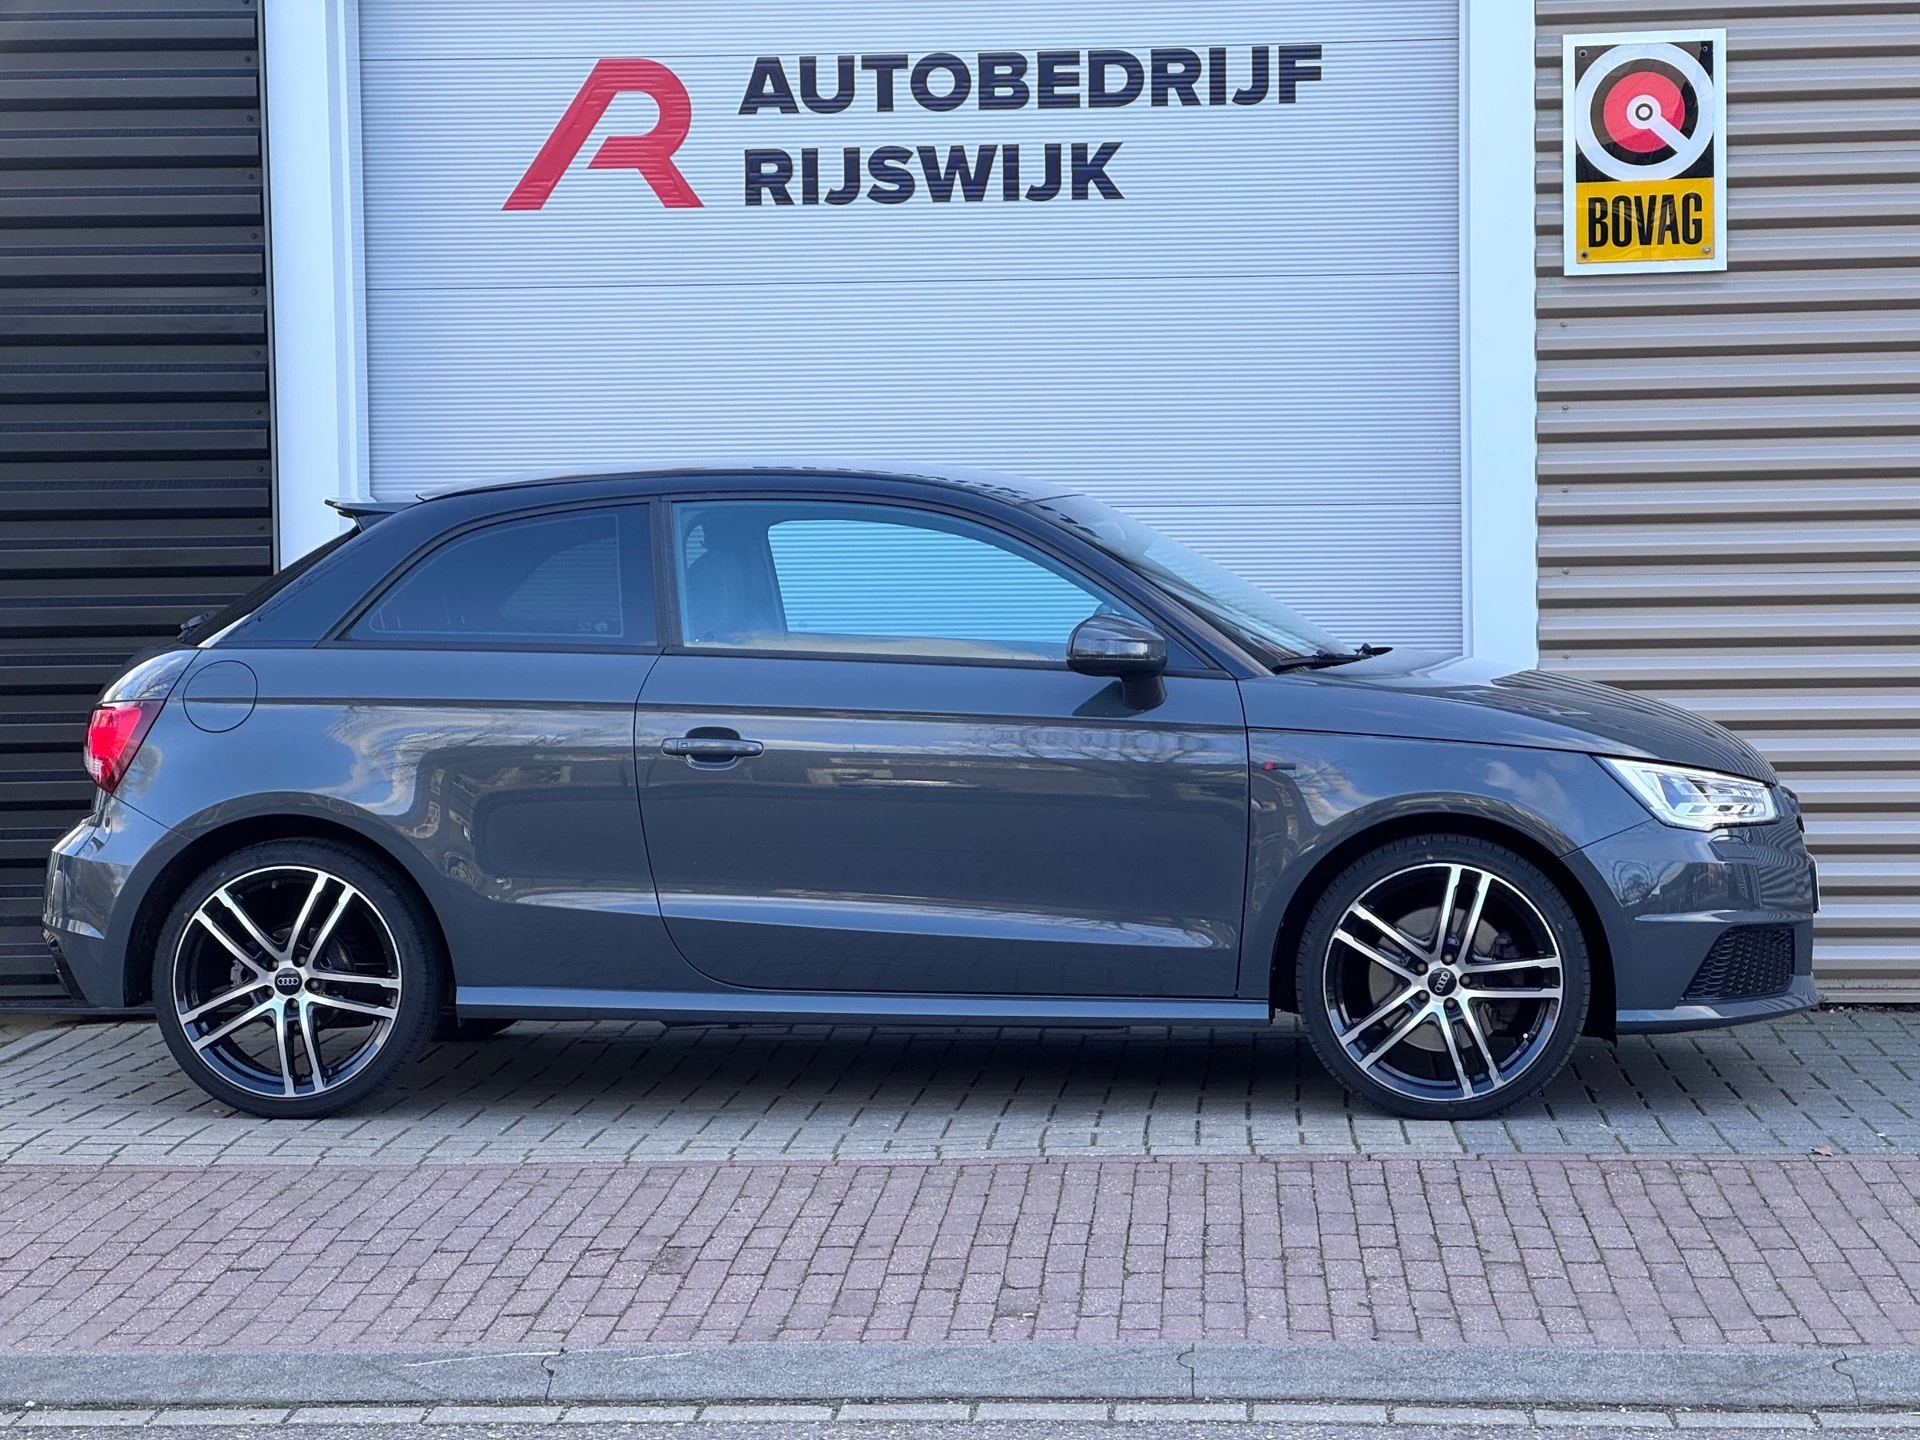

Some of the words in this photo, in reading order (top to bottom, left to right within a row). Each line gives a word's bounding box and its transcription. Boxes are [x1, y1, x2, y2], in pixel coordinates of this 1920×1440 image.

[738, 44, 1323, 115] AUTOBEDRIJF
[744, 142, 1125, 207] RIJSWIJK
[1588, 192, 1703, 248] BOVAG
